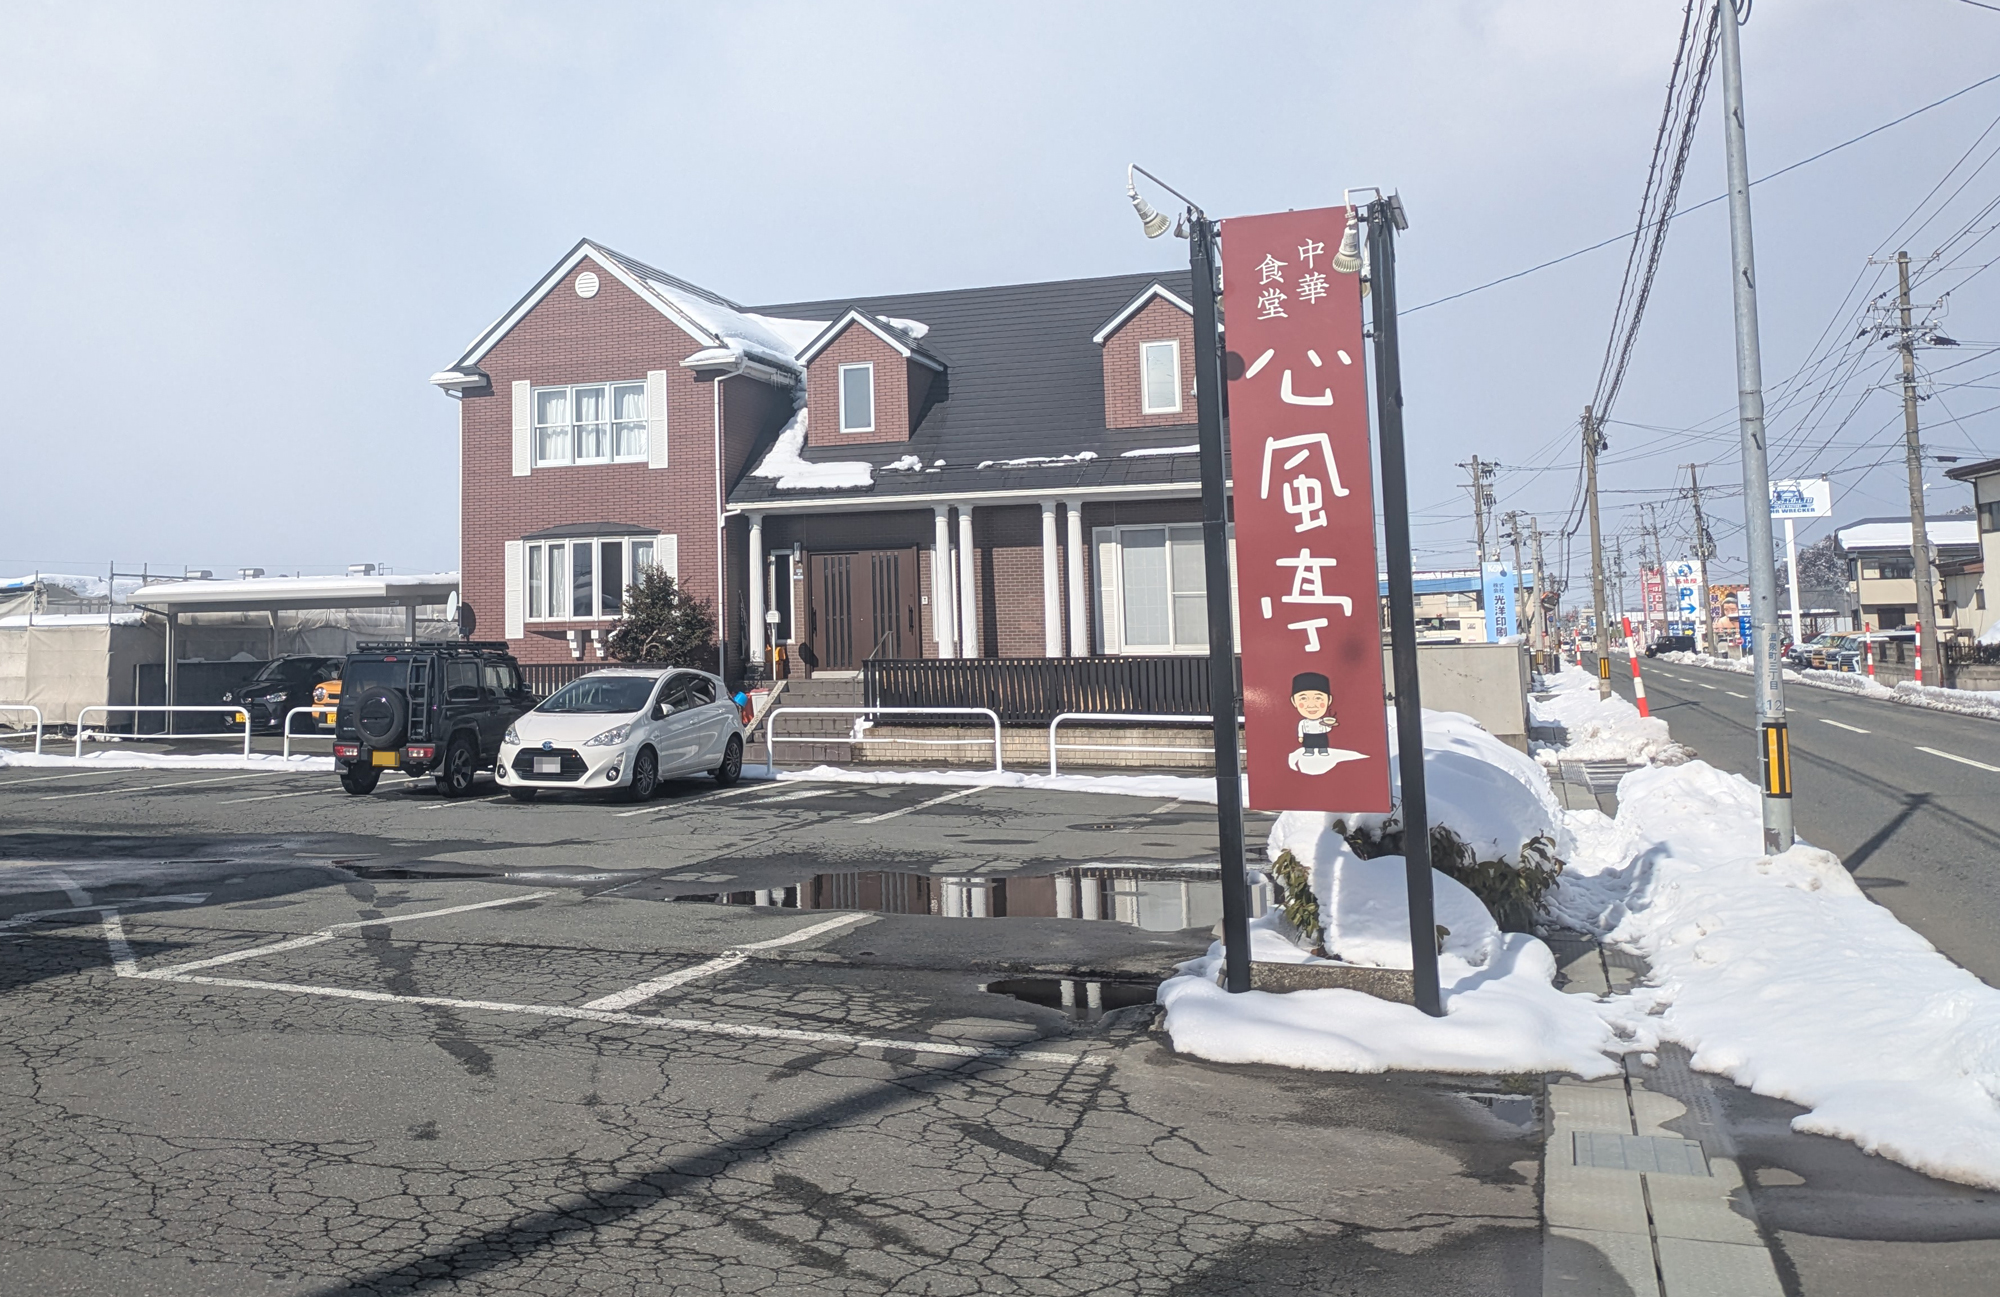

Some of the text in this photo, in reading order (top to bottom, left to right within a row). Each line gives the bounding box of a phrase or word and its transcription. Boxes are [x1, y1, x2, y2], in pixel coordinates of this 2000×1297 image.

[1254, 253, 1289, 321] 食堂
[1296, 238, 1330, 305] 中華
[1245, 348, 1353, 653] 心風亭
[1494, 594, 1508, 638] 光洋印刷
[1680, 587, 1694, 601] P
[1767, 632, 1779, 690] 温泉町三丁目
[1766, 699, 1782, 711] 12
